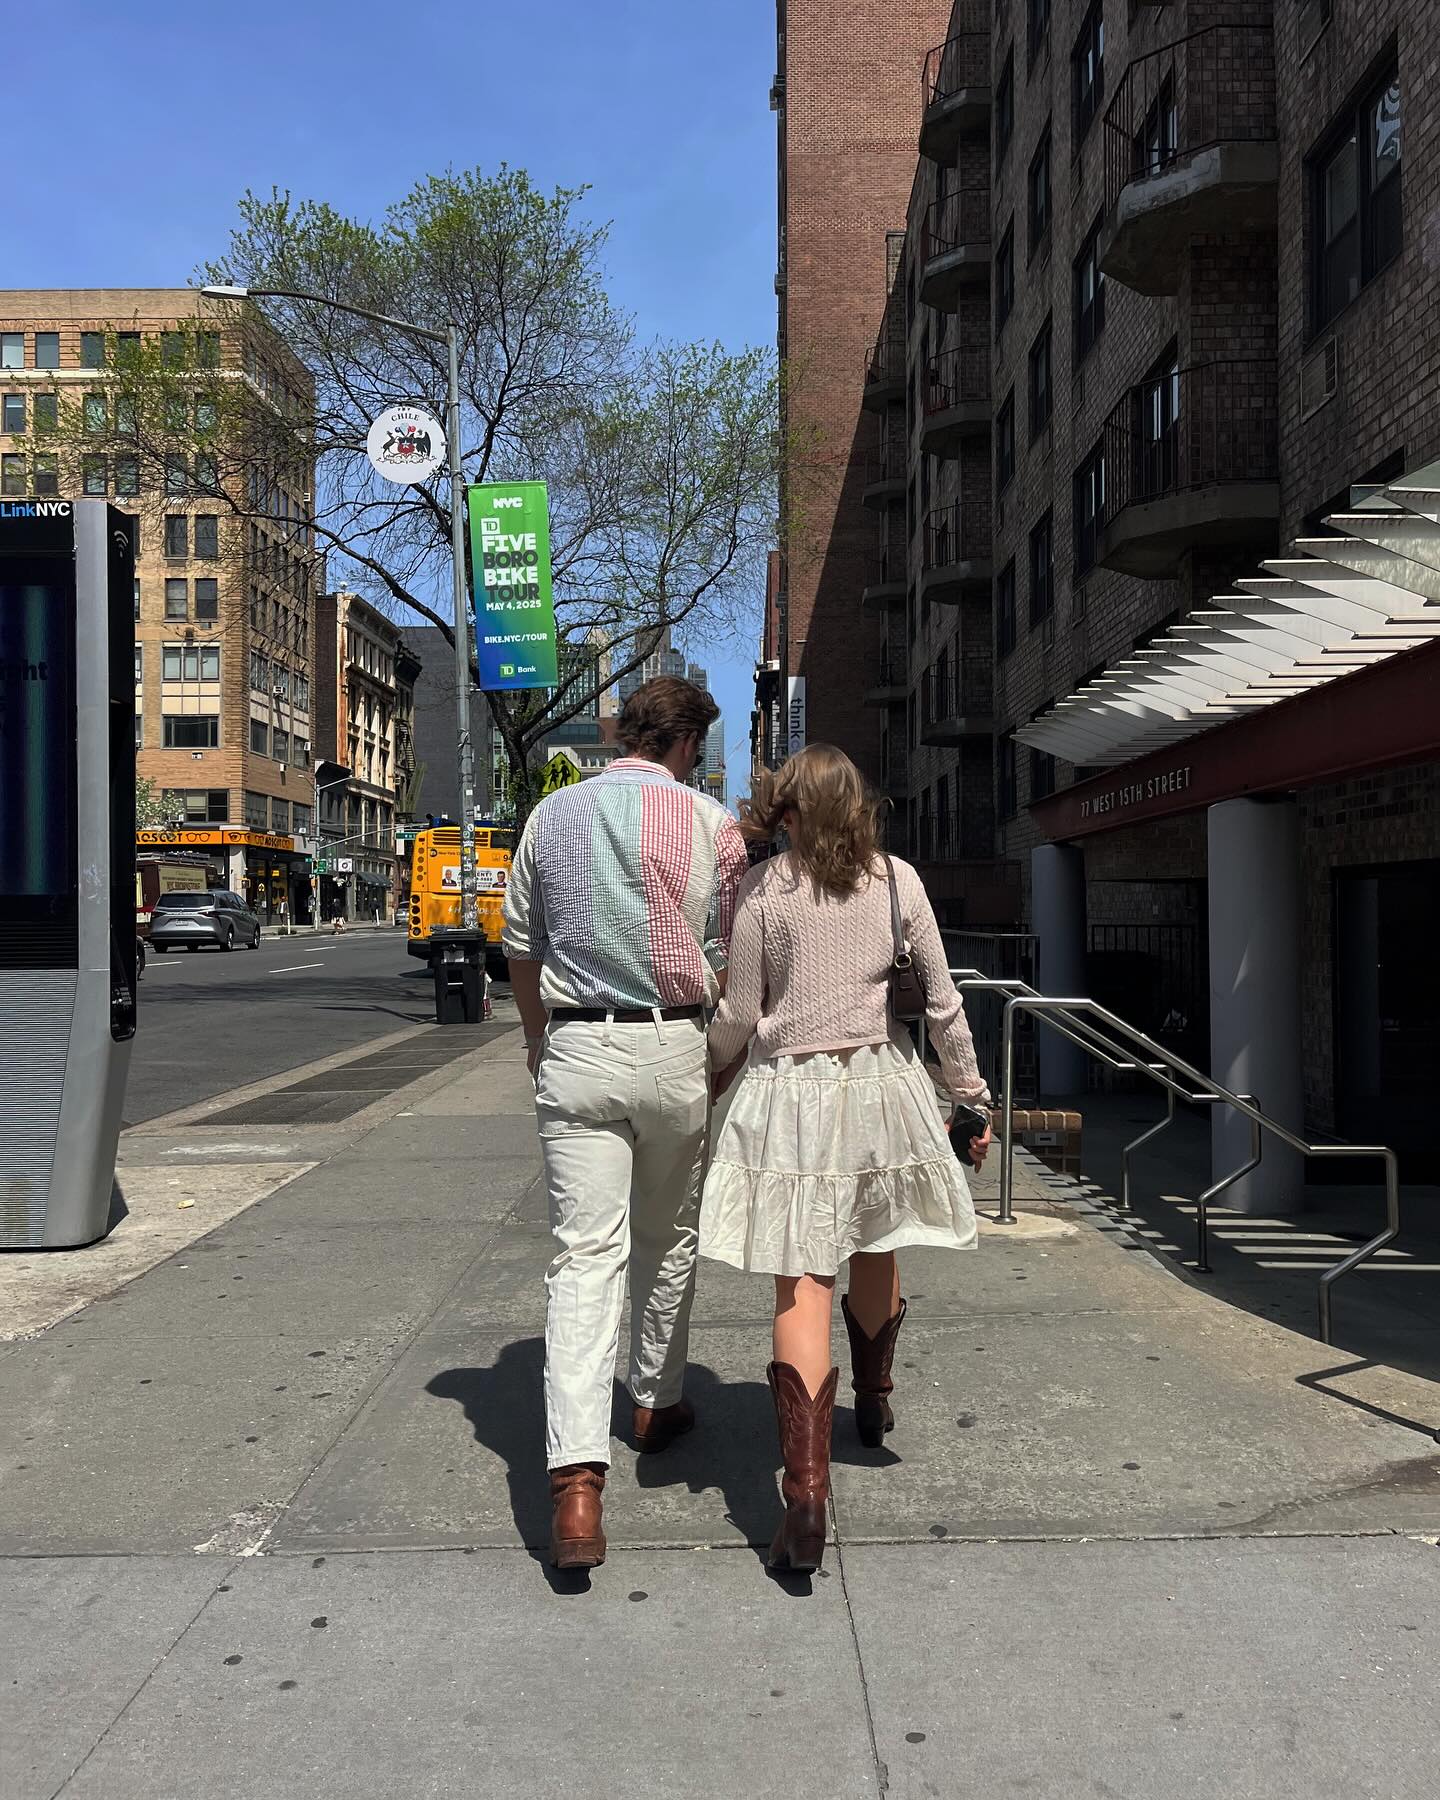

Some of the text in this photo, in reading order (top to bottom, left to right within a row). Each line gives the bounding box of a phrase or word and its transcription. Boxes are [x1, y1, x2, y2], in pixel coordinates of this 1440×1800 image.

[391, 413, 420, 422] CHILE
[1, 502, 70, 517] LinkNYC
[493, 497, 523, 509] NYC
[482, 520, 499, 532] TD
[482, 533, 536, 552] FIVE
[483, 550, 538, 569] BORO
[484, 566, 538, 586] BIKE
[485, 583, 540, 601] TOUR
[486, 602, 504, 611] MAY
[484, 633, 547, 644] BIKE.NYC/TOUR
[500, 665, 514, 676] TD
[1081, 767, 1190, 818] 77 WEST 15TH STREET
